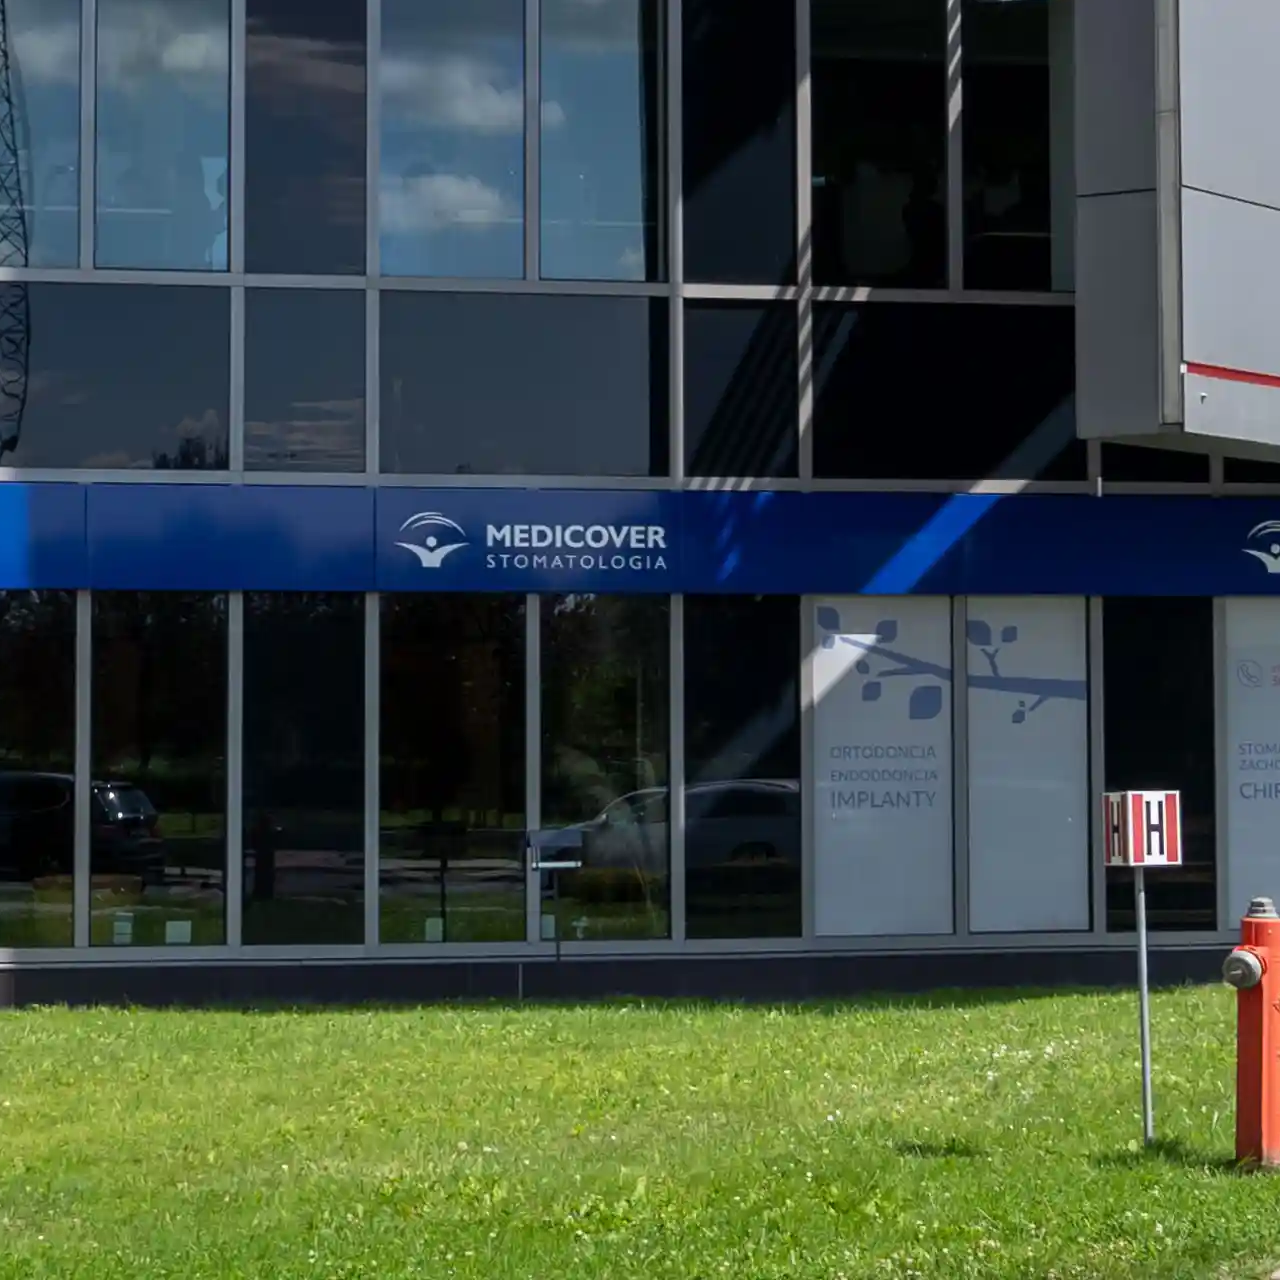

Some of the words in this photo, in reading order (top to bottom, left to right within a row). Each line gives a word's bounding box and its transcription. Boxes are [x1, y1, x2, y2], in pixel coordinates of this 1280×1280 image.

[486, 524, 667, 548] MEDICOVER
[486, 554, 667, 570] STOMATOLOGIA
[831, 790, 937, 809] IMPLANTY
[1145, 800, 1164, 856] H
